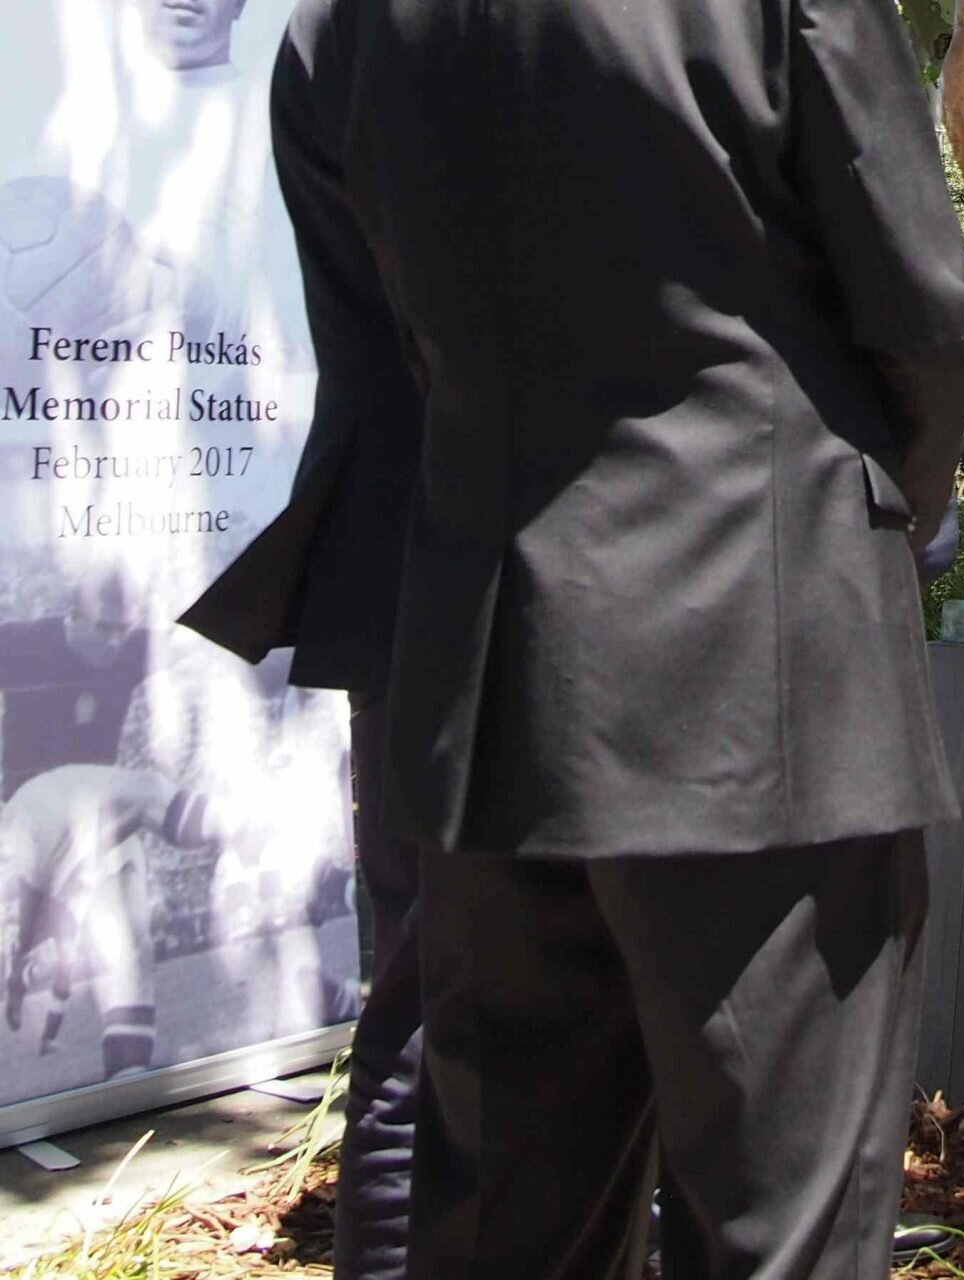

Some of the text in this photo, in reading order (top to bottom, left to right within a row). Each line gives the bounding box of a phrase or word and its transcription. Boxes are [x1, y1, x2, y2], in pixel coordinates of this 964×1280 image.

[28, 327, 262, 366] Ferenc Puskás
[1, 387, 278, 422] Memorial Statue
[31, 445, 254, 488] February 2017
[57, 502, 229, 538] Melbourne
